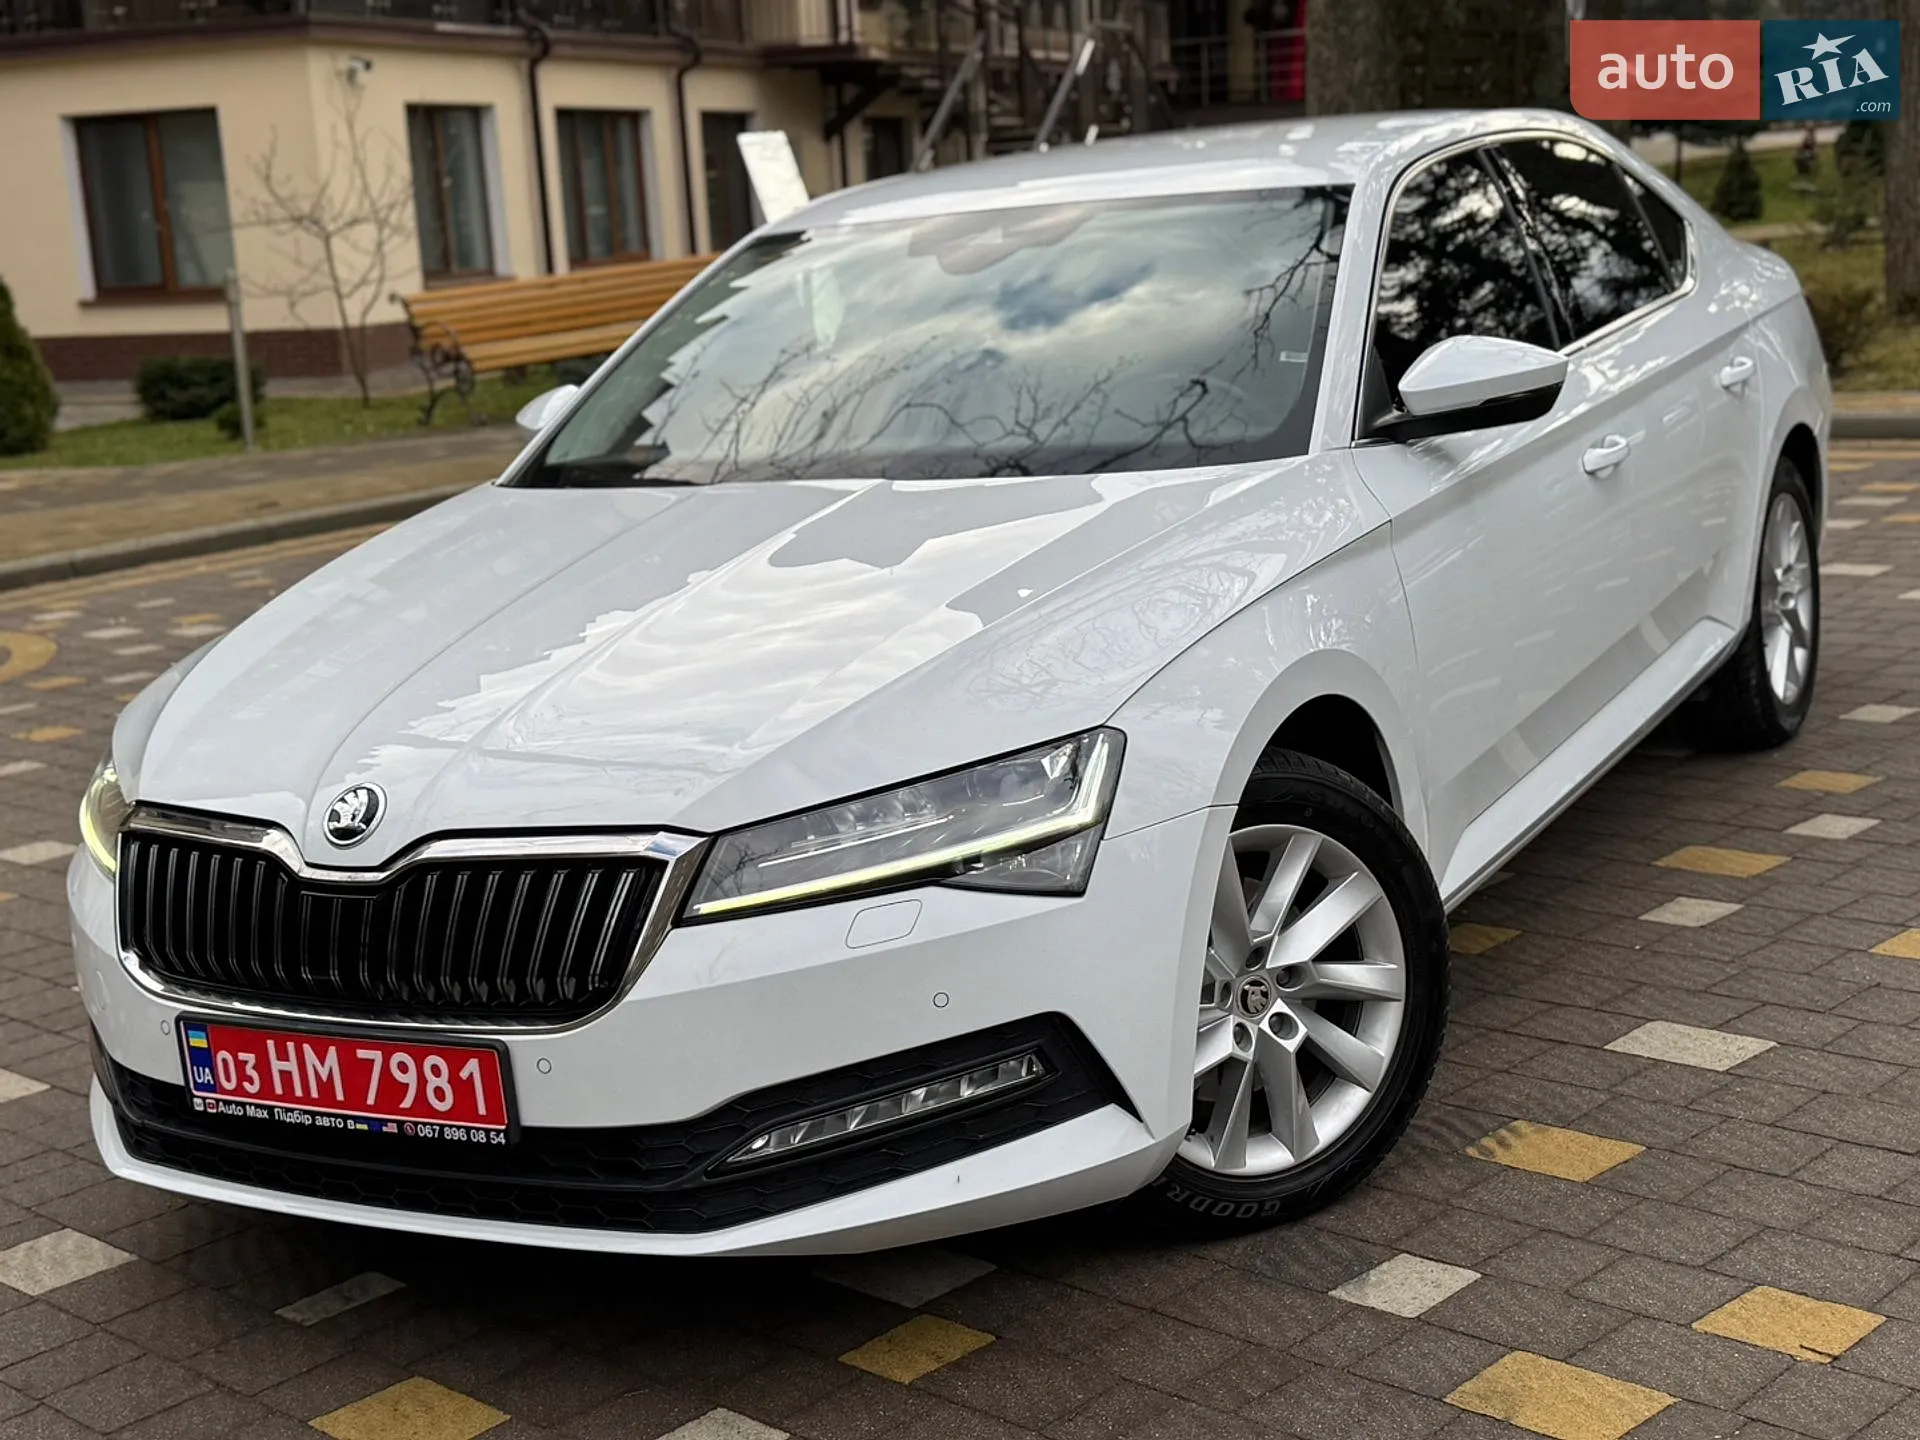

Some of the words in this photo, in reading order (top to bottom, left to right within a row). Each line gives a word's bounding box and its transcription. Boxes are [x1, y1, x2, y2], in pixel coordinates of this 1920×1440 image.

[193, 1066, 214, 1085] UA
[215, 1050, 261, 1094] 03
[356, 1049, 487, 1116] 7981
[218, 1101, 244, 1116] Auto
[246, 1104, 269, 1119] Max
[274, 1107, 312, 1126] Підбір
[417, 1124, 439, 1138] 067
[443, 1126, 467, 1141] 896
[470, 1130, 486, 1143] 08
[490, 1131, 506, 1145] 54
